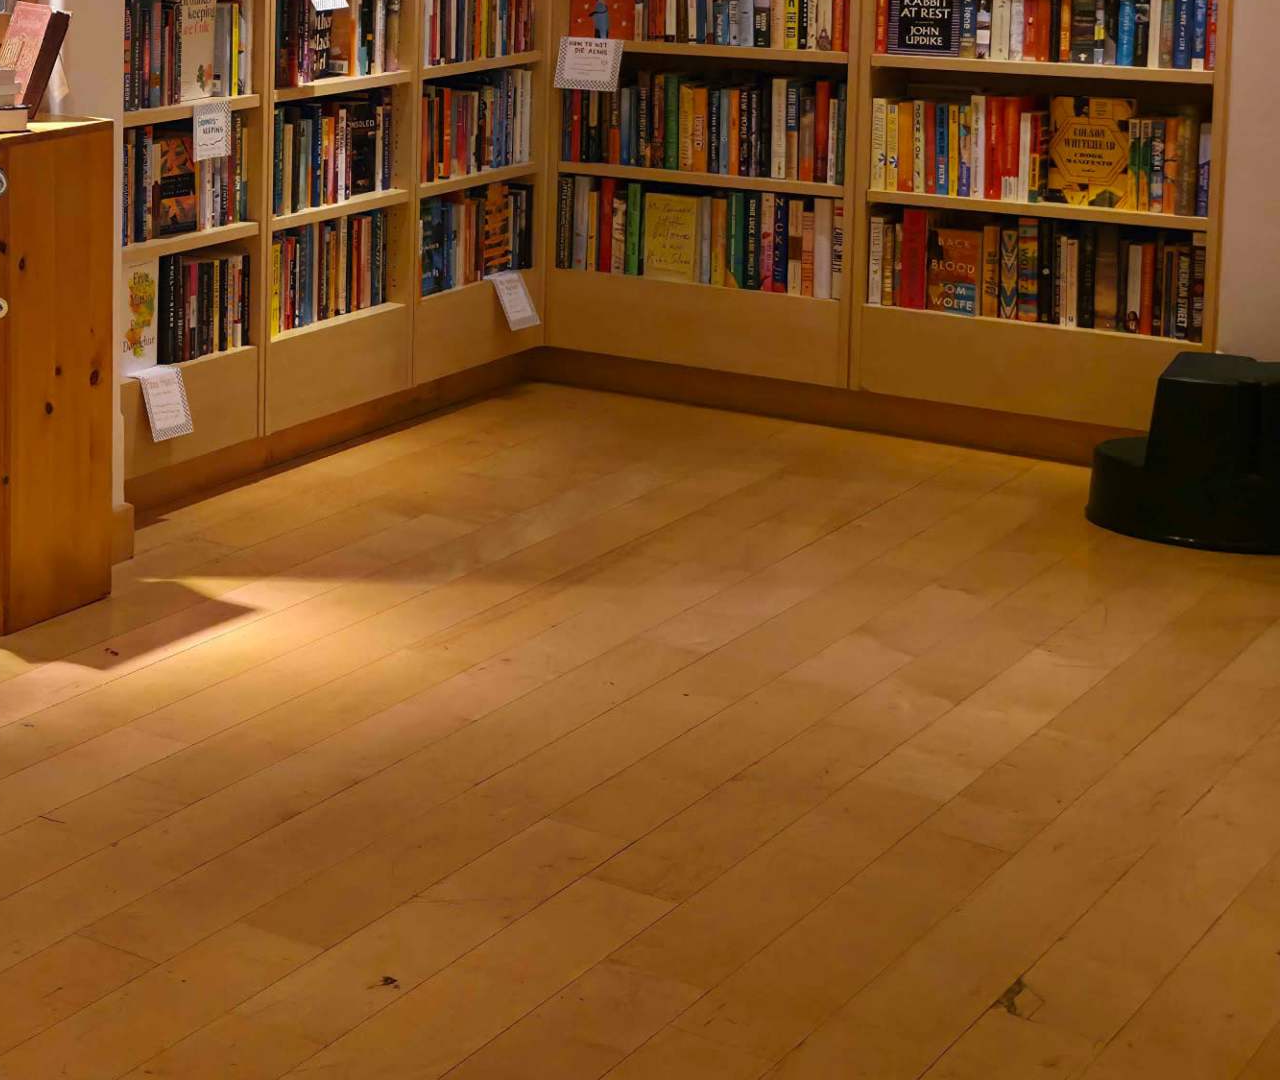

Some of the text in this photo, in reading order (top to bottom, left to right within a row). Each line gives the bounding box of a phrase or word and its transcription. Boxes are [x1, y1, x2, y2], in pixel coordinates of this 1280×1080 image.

[187, 4, 216, 22] keeping
[901, 8, 951, 19] AT REST
[963, 6, 972, 30] Irene
[910, 26, 940, 37] JOHN
[905, 35, 943, 47] UPDIKE
[930, 258, 975, 275] BLOOD
[931, 296, 974, 312] WOLFE
